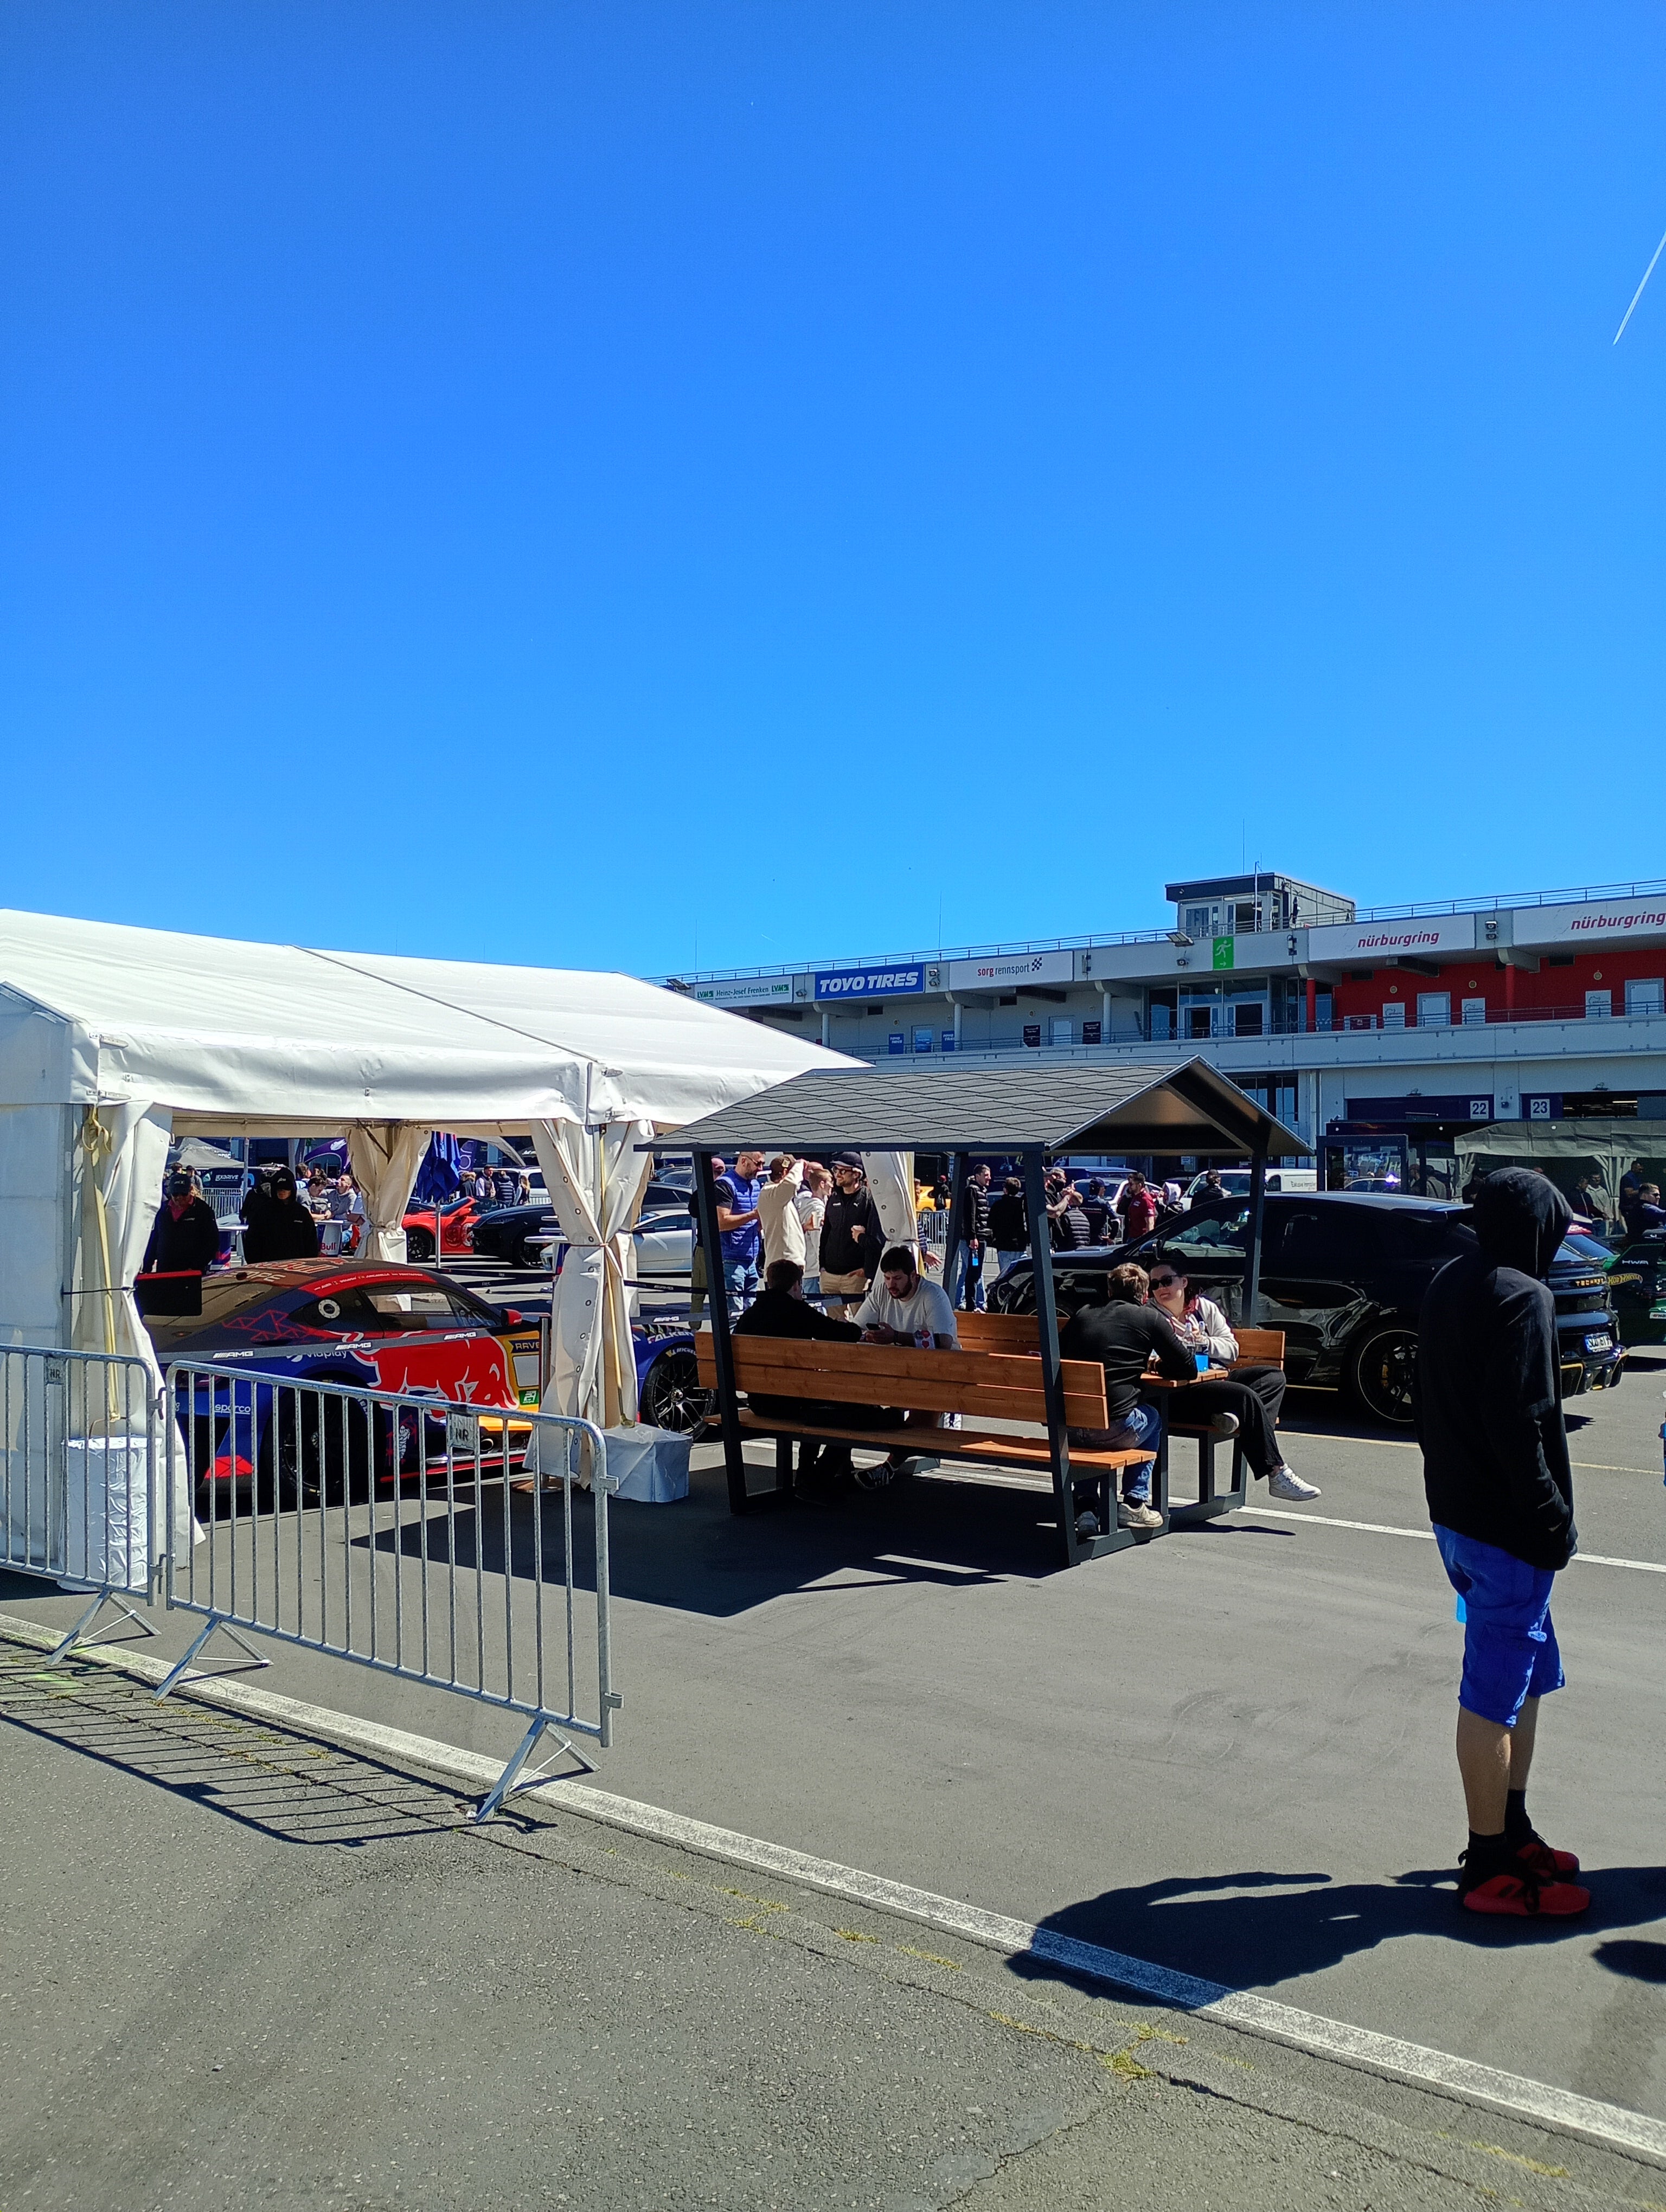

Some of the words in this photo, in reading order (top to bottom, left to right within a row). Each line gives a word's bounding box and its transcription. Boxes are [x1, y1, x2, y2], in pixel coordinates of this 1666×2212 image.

[1571, 911, 1666, 930] nürburgring
[1358, 931, 1439, 948] nürburgring
[977, 968, 994, 977] sorg
[995, 963, 1030, 975] rennsport
[820, 976, 865, 993] TOYO
[868, 972, 919, 989] TIRES
[716, 987, 746, 996] Heinz-Josef
[748, 986, 769, 994] Frenken
[1472, 1102, 1486, 1115] 22
[1533, 1101, 1547, 1114] 23
[321, 1242, 336, 1250] Bull
[647, 1332, 694, 1344] FALKEN
